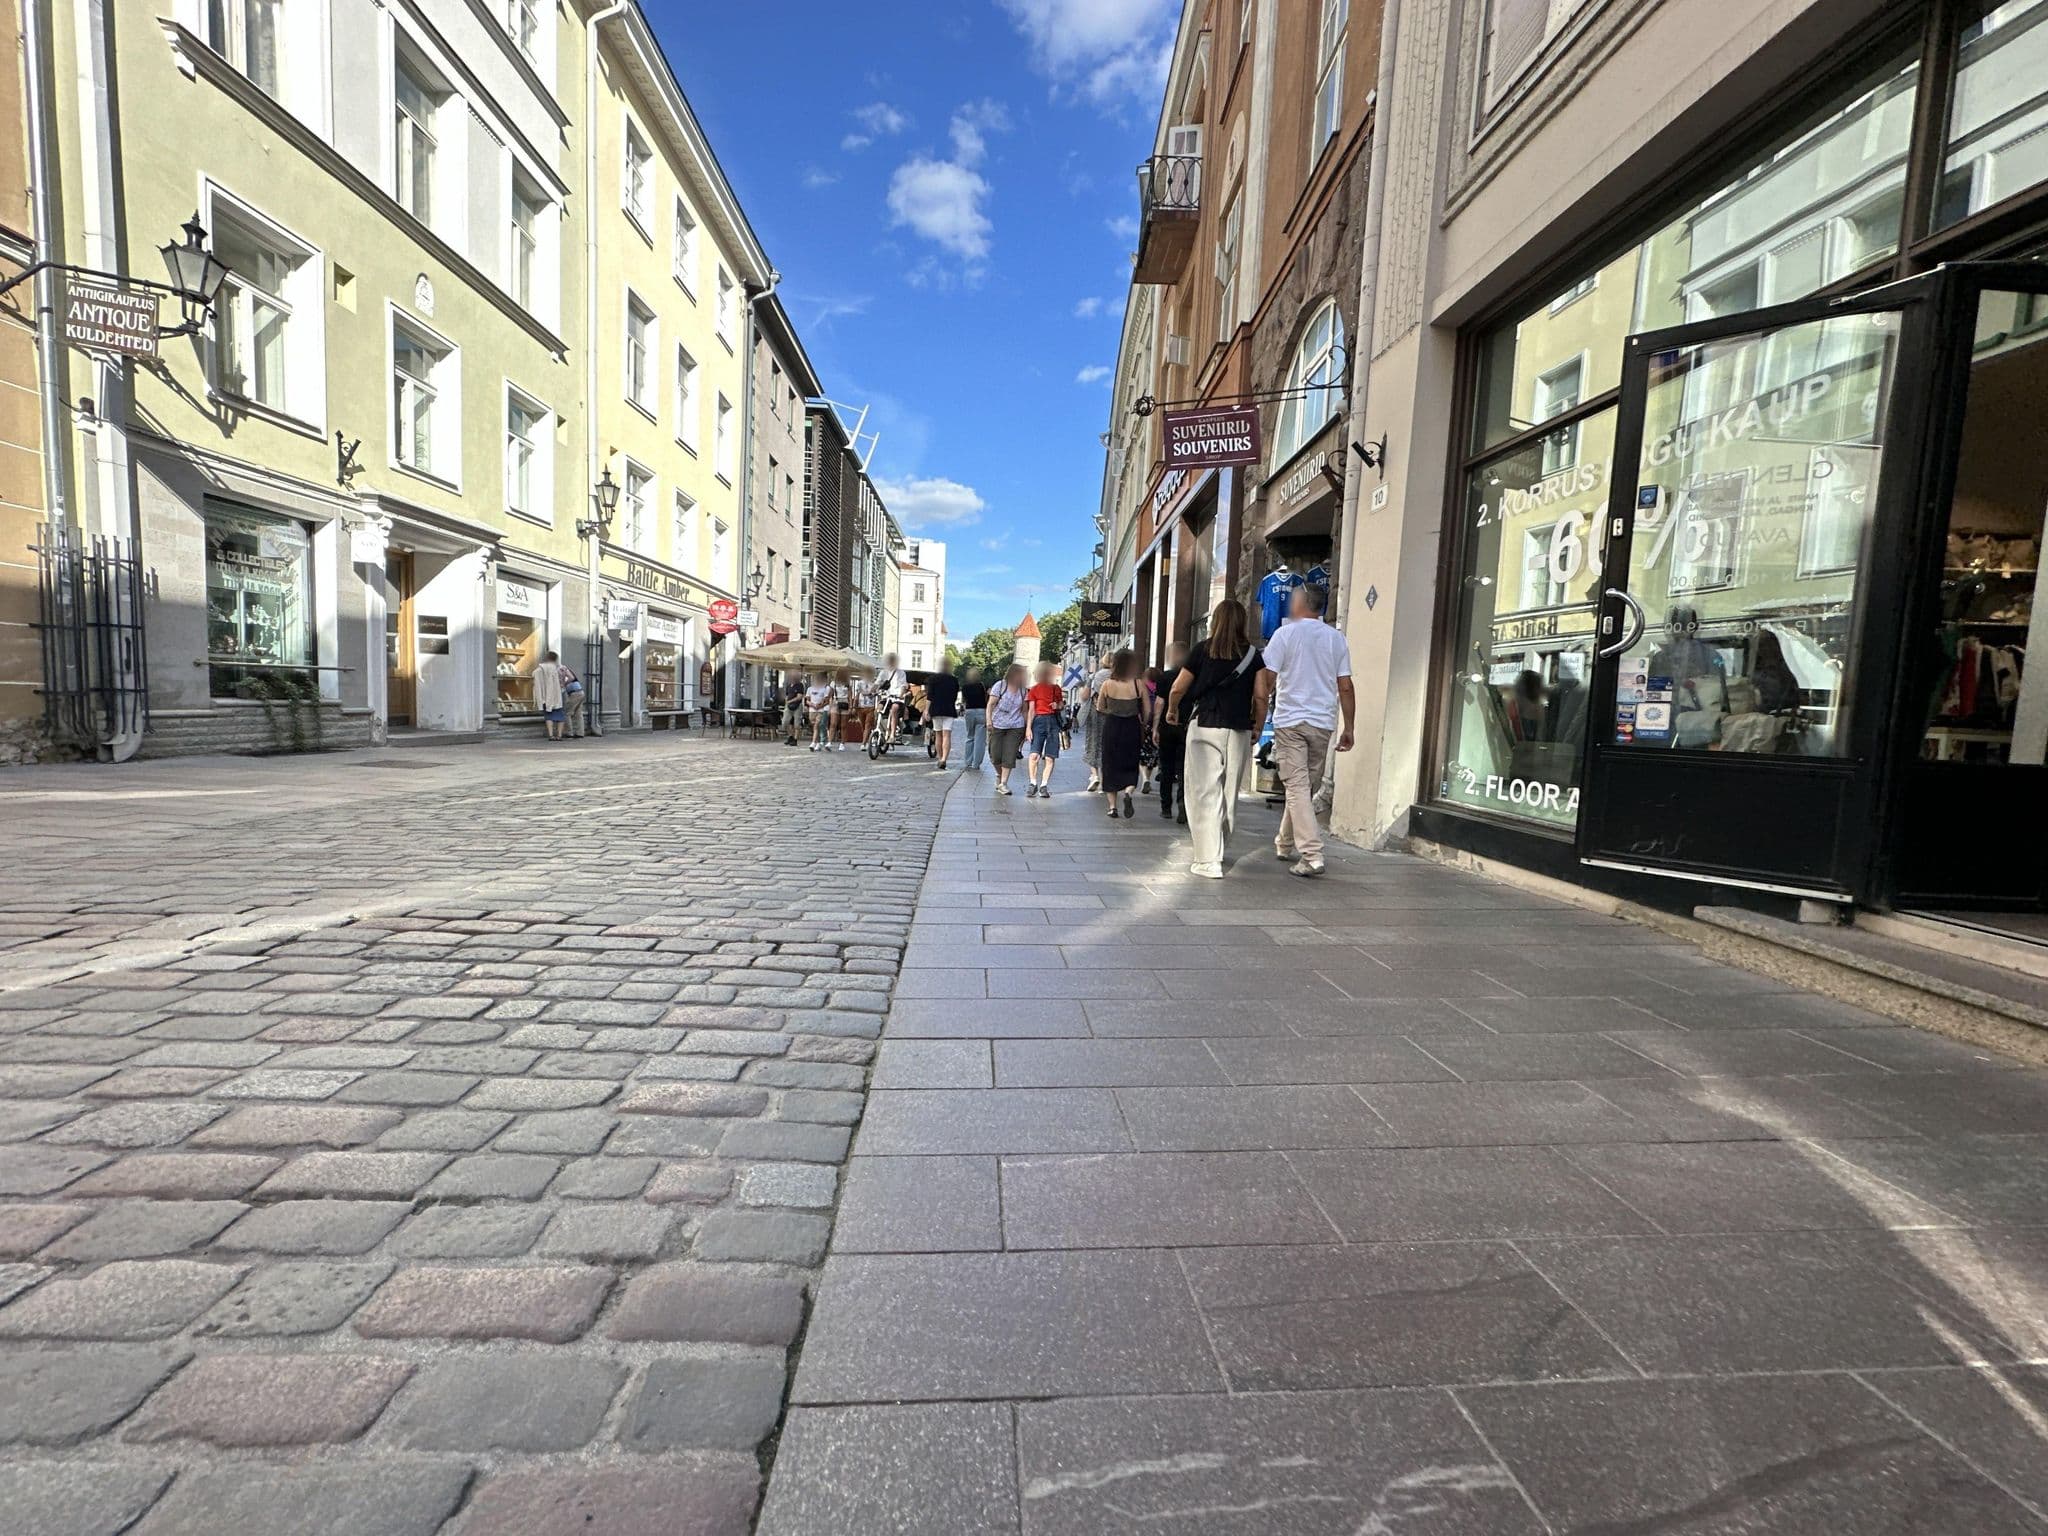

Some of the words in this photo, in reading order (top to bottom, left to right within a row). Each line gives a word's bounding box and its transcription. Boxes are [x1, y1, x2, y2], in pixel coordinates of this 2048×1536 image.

[69, 301, 151, 332] ANTIQUE
[65, 324, 153, 351] KULDEHTED
[1172, 420, 1251, 440] SUVENIIRID
[1173, 436, 1252, 457] SOUVENIRS
[1476, 503, 1491, 527] 2.
[1498, 463, 1596, 521] KORRUS
[1709, 374, 1832, 449] KAUP
[1279, 451, 1325, 505] SUVENIIRID
[1374, 490, 1384, 506] 10
[506, 583, 528, 601] S&A
[628, 562, 659, 591] Baltic
[660, 576, 690, 602] Amber
[1464, 772, 1480, 796] 2.
[1485, 774, 1560, 811] FLOOR
